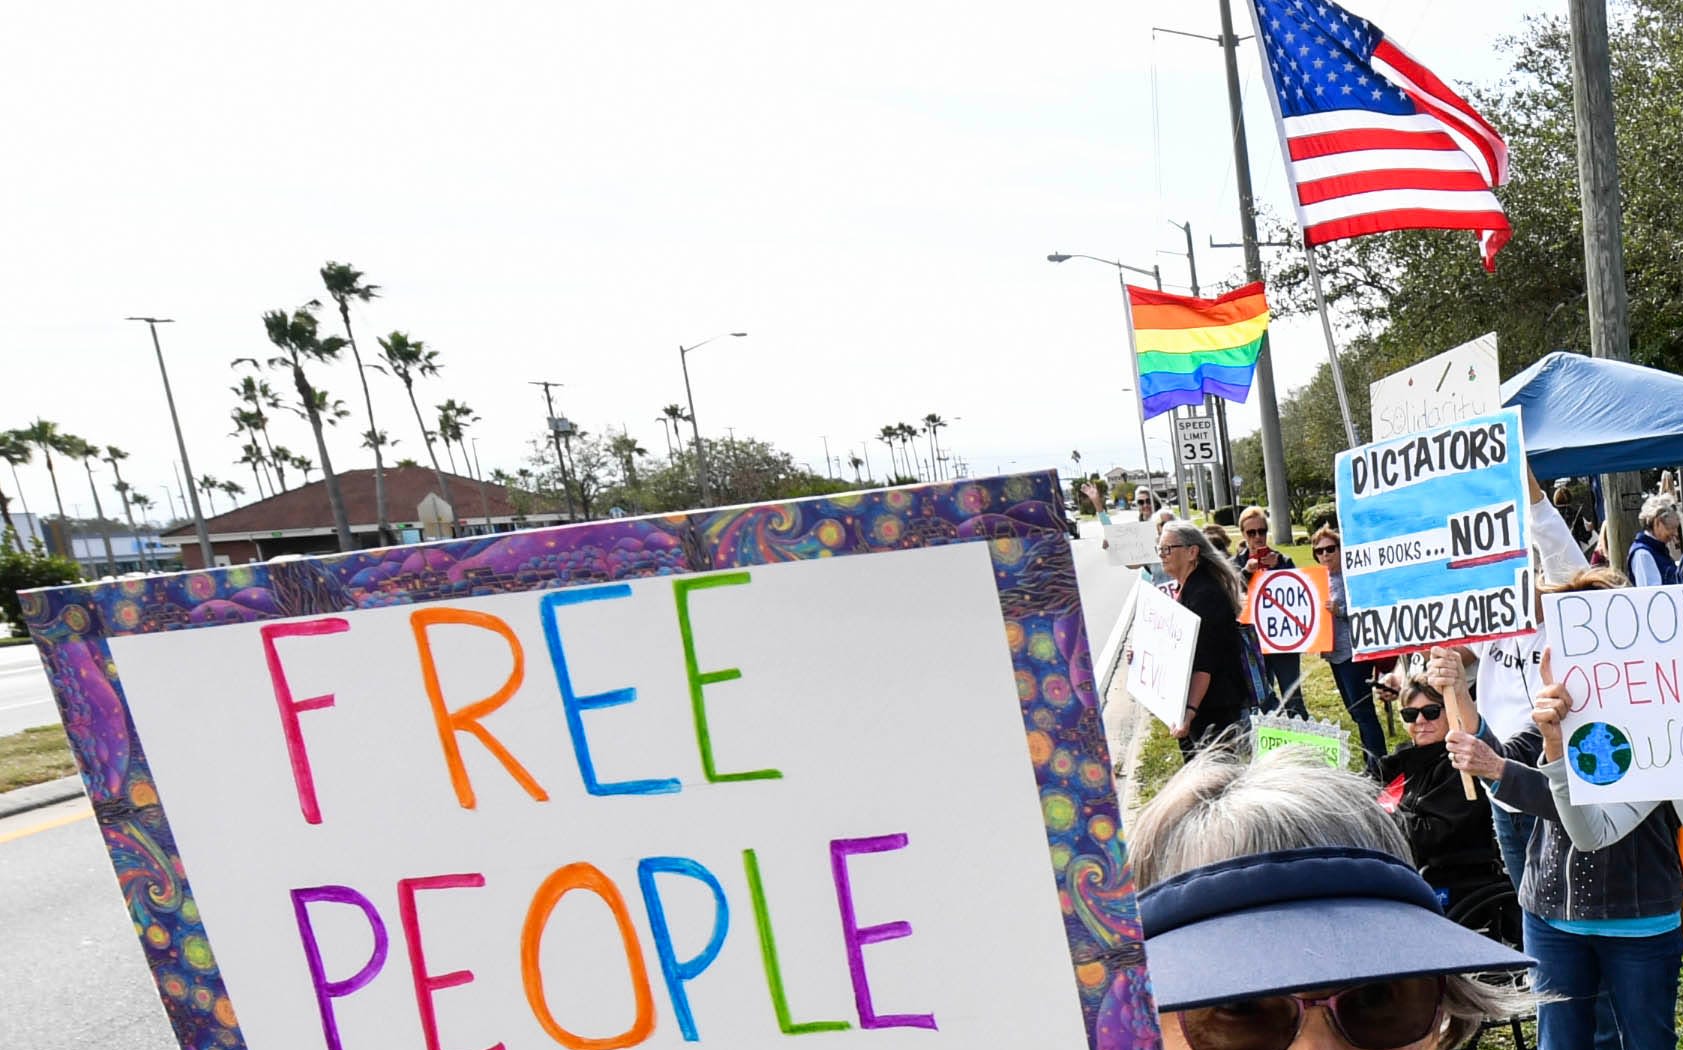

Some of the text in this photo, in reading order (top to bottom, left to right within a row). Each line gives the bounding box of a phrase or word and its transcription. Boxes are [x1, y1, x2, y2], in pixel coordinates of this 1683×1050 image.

[1179, 421, 1211, 430] SPEED
[1184, 431, 1208, 440] LIMIT
[1184, 443, 1213, 460] 35
[1352, 423, 1506, 495] DICTATORS
[1345, 549, 1371, 569] BAN
[1450, 504, 1514, 556] NOT
[1263, 586, 1308, 609] BOOK
[1268, 616, 1306, 637] BAN
[1562, 659, 1680, 713] OPEN
[261, 571, 782, 825] FREE
